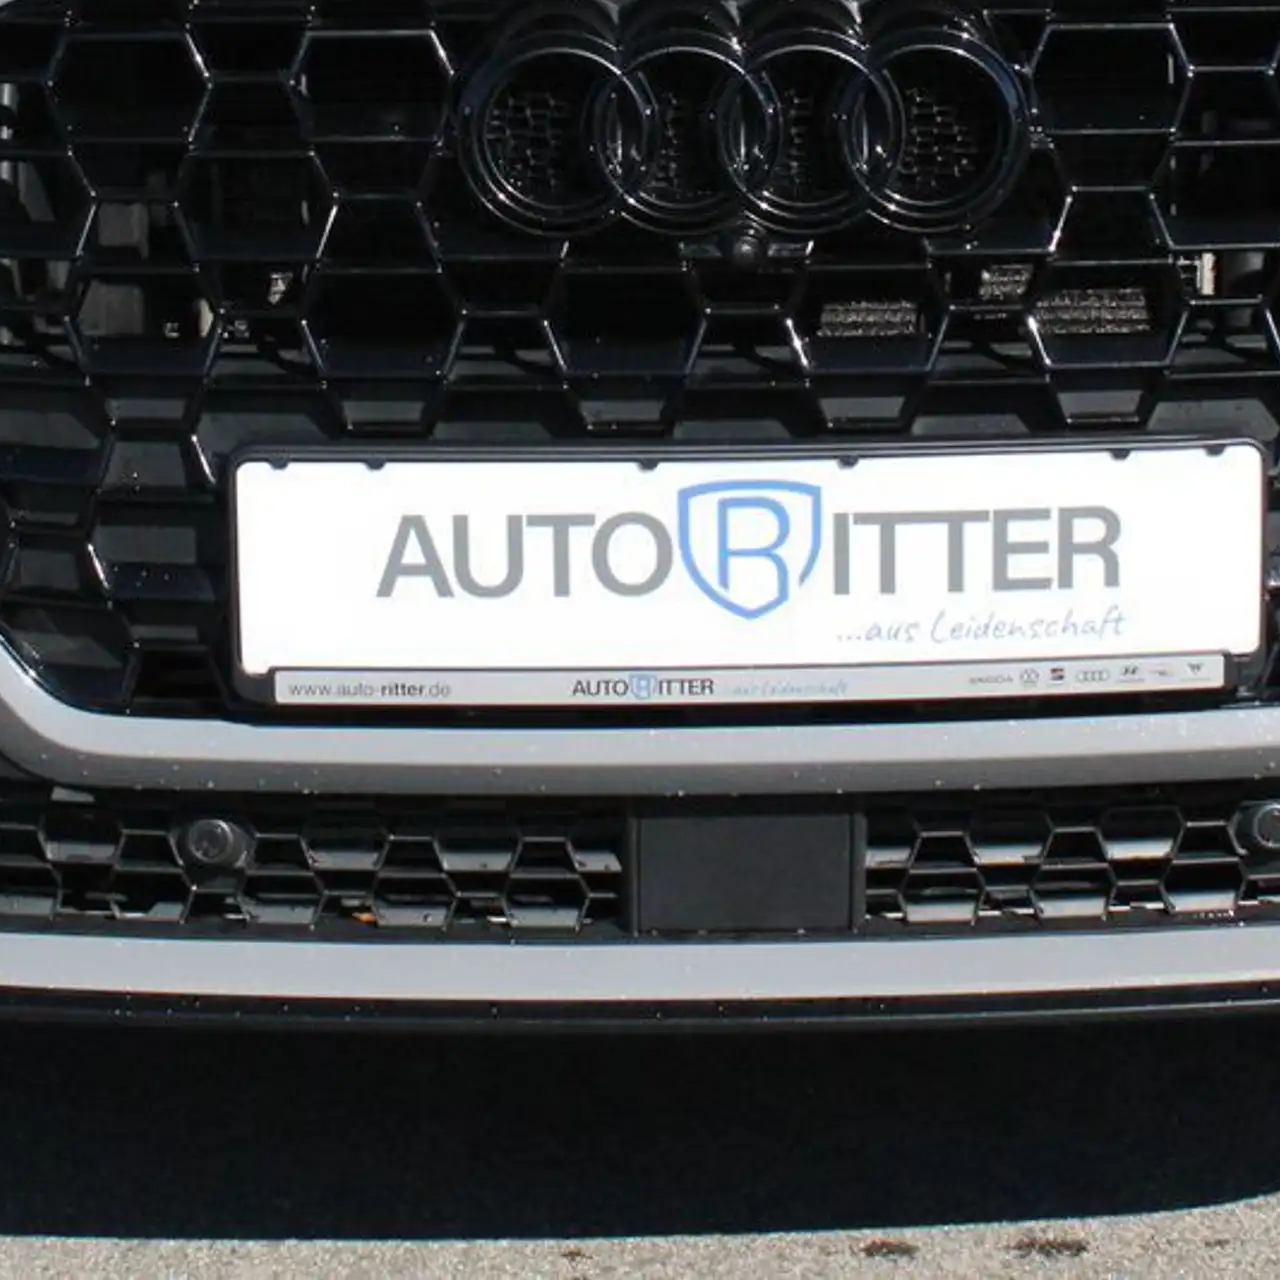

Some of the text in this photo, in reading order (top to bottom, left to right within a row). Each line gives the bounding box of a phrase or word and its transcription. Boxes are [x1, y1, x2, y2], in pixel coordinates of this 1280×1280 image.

[375, 511, 674, 599] AUTO
[929, 604, 1126, 644] Leidenschaft
[572, 679, 630, 697] AUTO
